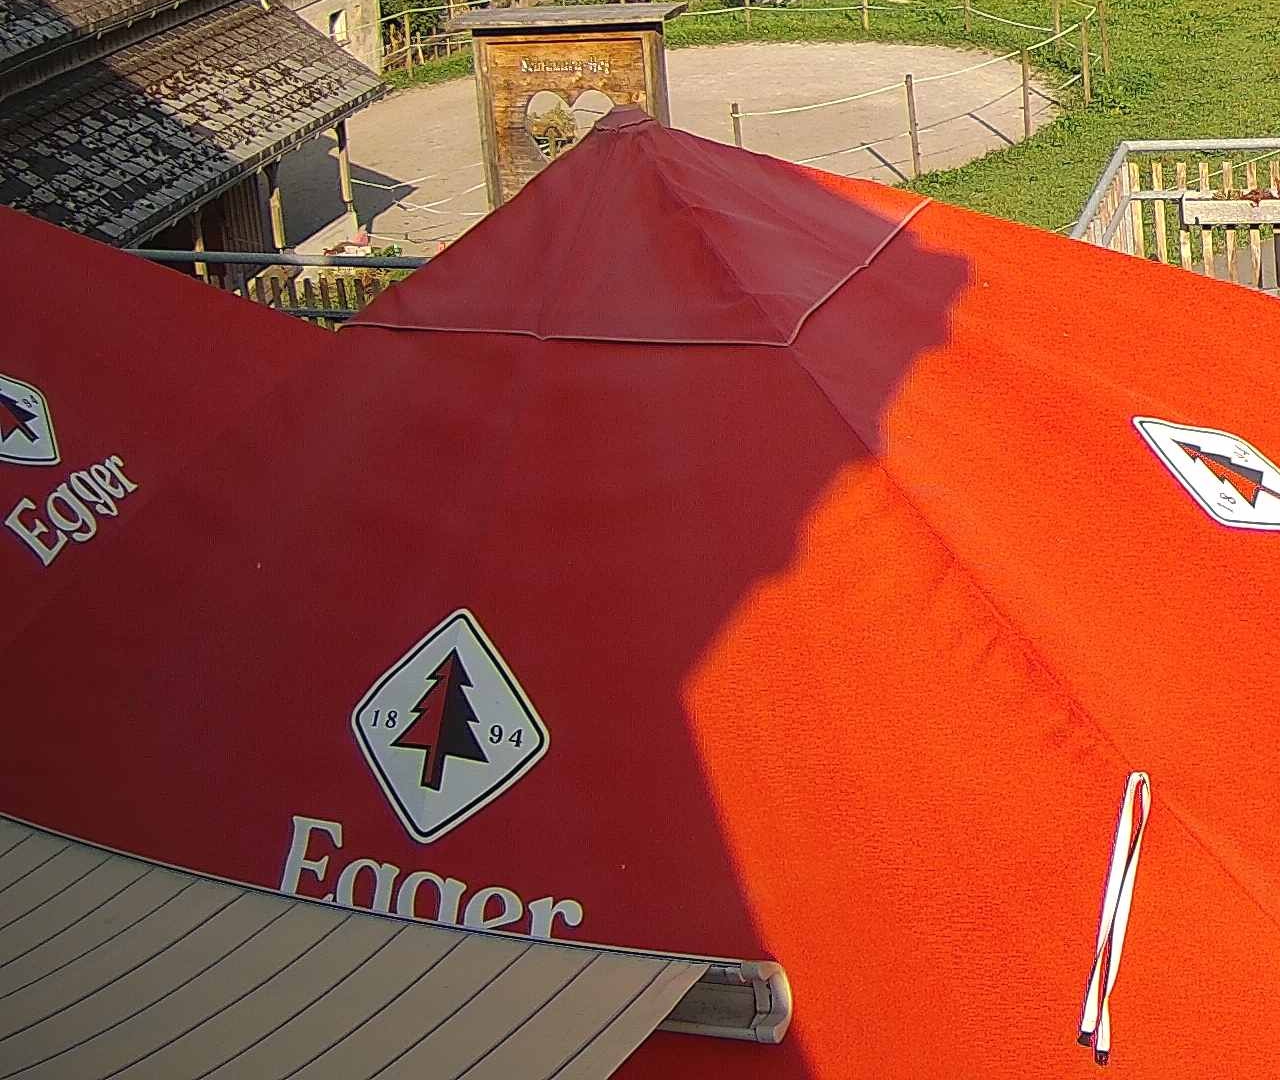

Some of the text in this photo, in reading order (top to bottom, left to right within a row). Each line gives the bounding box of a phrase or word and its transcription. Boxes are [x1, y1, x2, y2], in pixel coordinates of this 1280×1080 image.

[4, 455, 139, 567] Egger
[369, 708, 525, 748] 18 94
